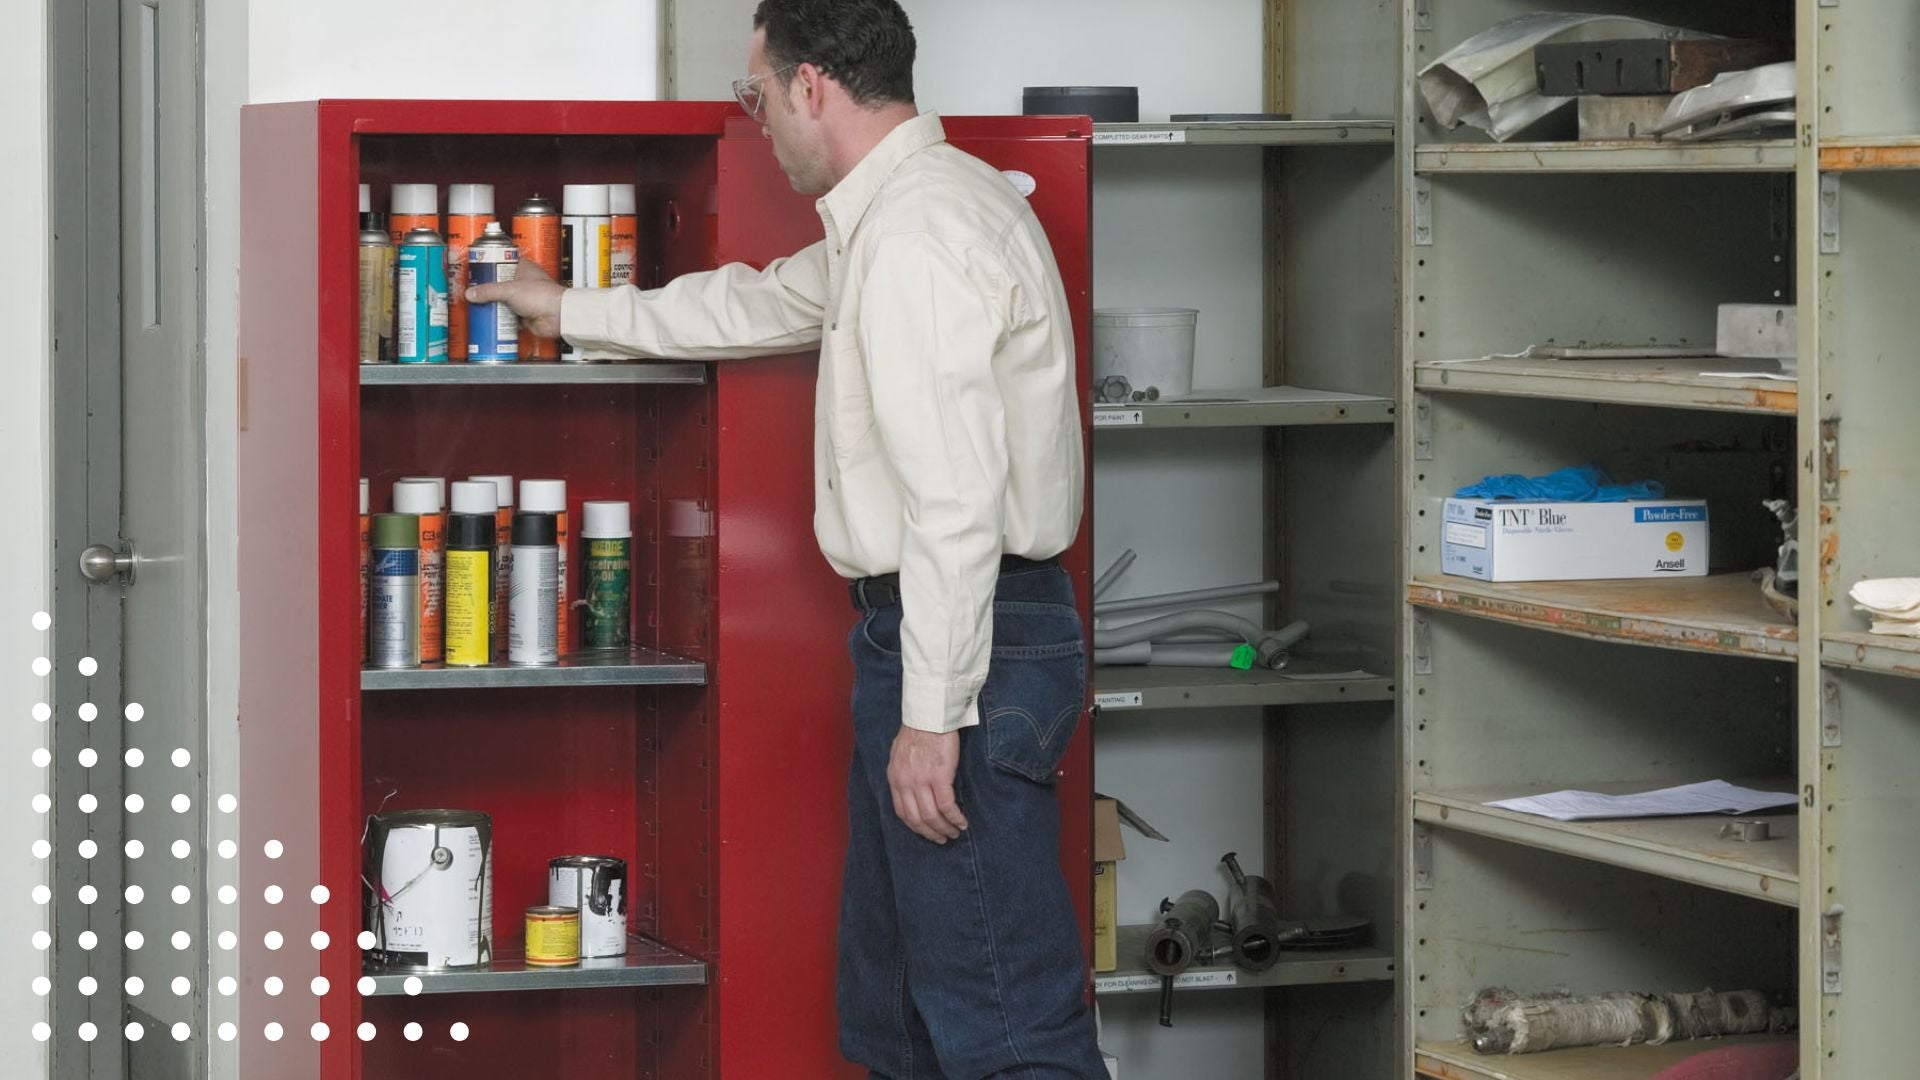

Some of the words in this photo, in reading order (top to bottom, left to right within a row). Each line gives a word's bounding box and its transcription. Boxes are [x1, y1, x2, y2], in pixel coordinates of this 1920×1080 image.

[1539, 508, 1567, 525] Blue
[1643, 508, 1699, 521] Powder-Free
[1655, 558, 1685, 568] Ansell
[1804, 784, 1815, 808] 3
